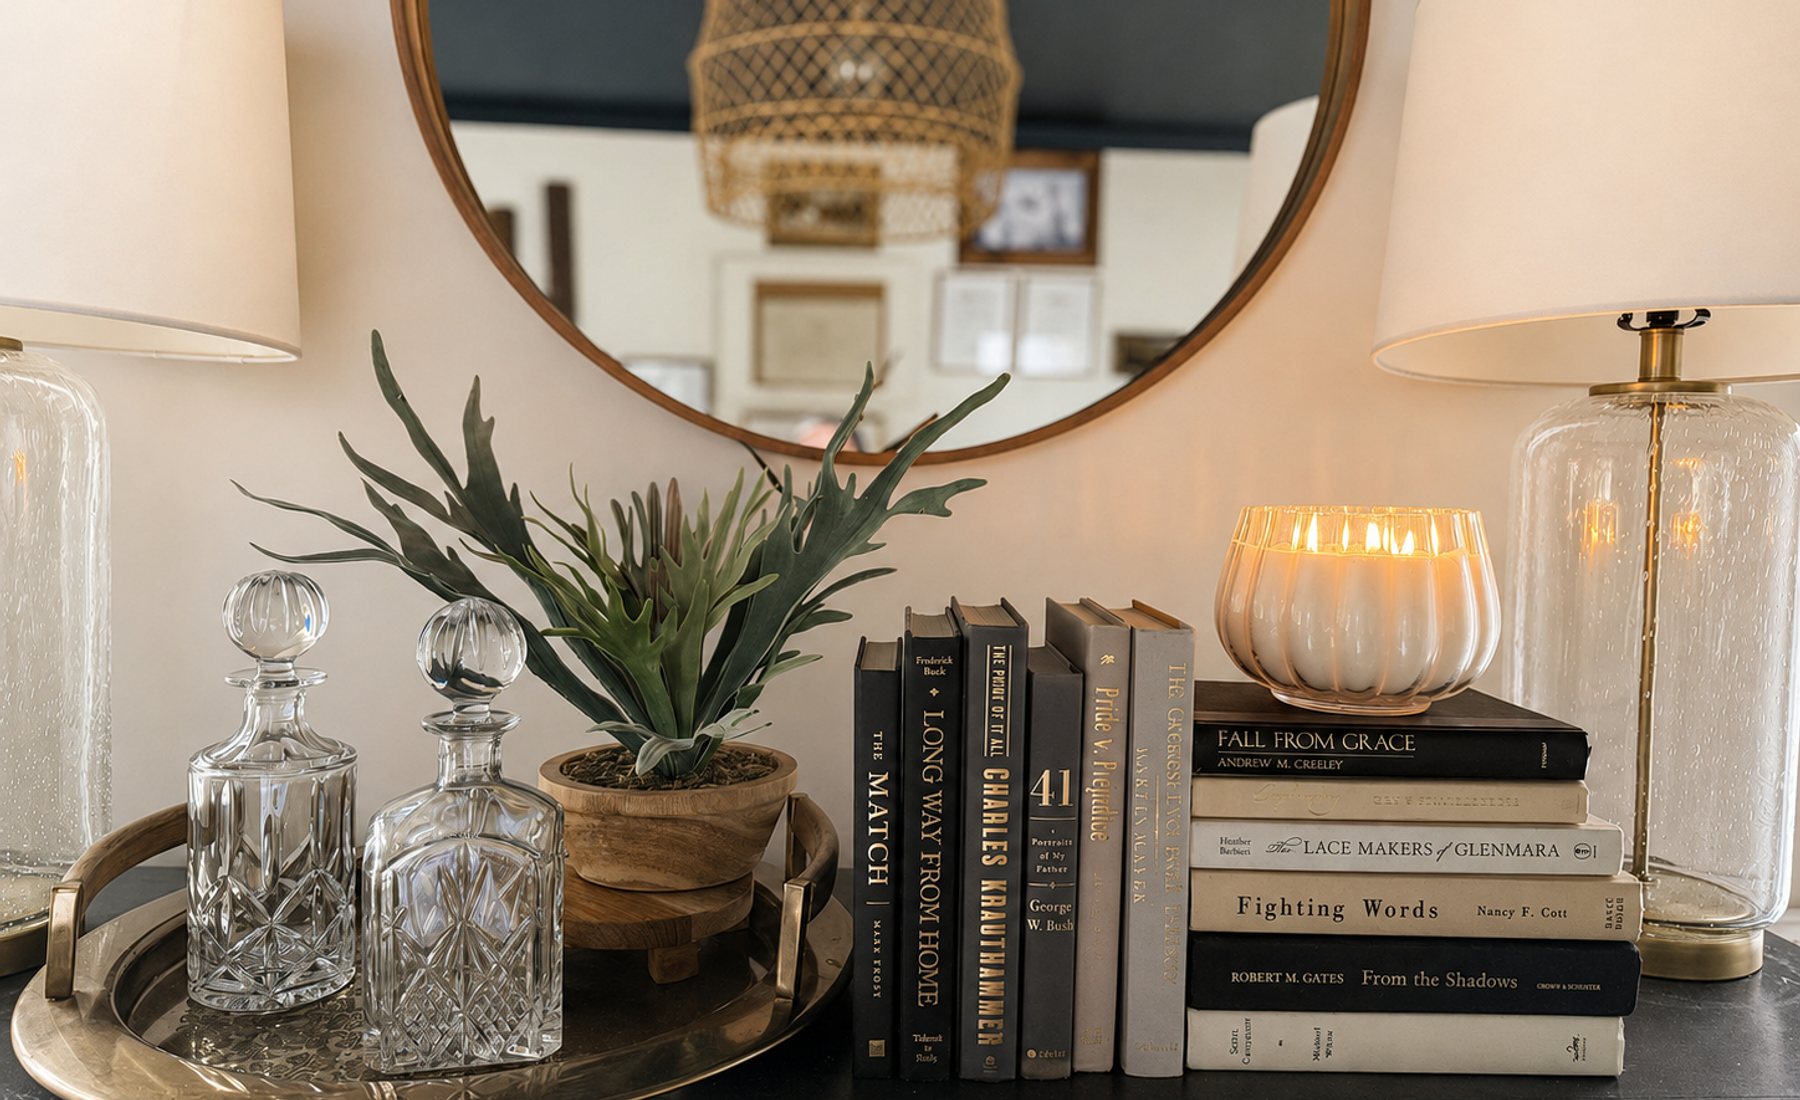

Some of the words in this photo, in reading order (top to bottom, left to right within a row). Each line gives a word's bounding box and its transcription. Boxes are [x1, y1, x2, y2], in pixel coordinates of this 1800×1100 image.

[993, 645, 1006, 666] THE
[1094, 687, 1119, 732] Pride
[873, 731, 883, 760] THE
[921, 710, 944, 784] LONG
[1218, 729, 1266, 750] FALL
[1273, 730, 1334, 751] FROM
[1342, 732, 1416, 752] GRACE
[1218, 757, 1272, 769] ANDREW
[1277, 758, 1292, 769] M.
[1029, 769, 1074, 806] 41
[868, 772, 889, 886] MATCH
[920, 790, 943, 845] WAY
[981, 768, 1009, 867] CHARLES
[1039, 852, 1050, 860] of
[1304, 841, 1351, 855] LACE
[1358, 842, 1433, 856] MAKERS
[1436, 841, 1453, 863] of
[1454, 843, 1560, 858] GLENMARA
[919, 852, 942, 924] FROM
[1029, 899, 1073, 915] George
[1237, 896, 1345, 922] Fighting
[1363, 899, 1439, 919] Words
[1477, 905, 1515, 919] Nancy
[1522, 907, 1534, 917] F.
[1541, 907, 1567, 918] Cott
[1027, 919, 1043, 931] W.
[1046, 919, 1074, 931] Bush
[917, 930, 940, 1007] HOME
[978, 879, 1006, 1046] KRAUTHAMMER
[1231, 972, 1282, 983] ROBERT
[1285, 973, 1299, 983] M.
[1303, 973, 1344, 984] GATES
[1361, 969, 1407, 986] From
[1413, 970, 1439, 986] the
[1445, 971, 1518, 989] Shadows
